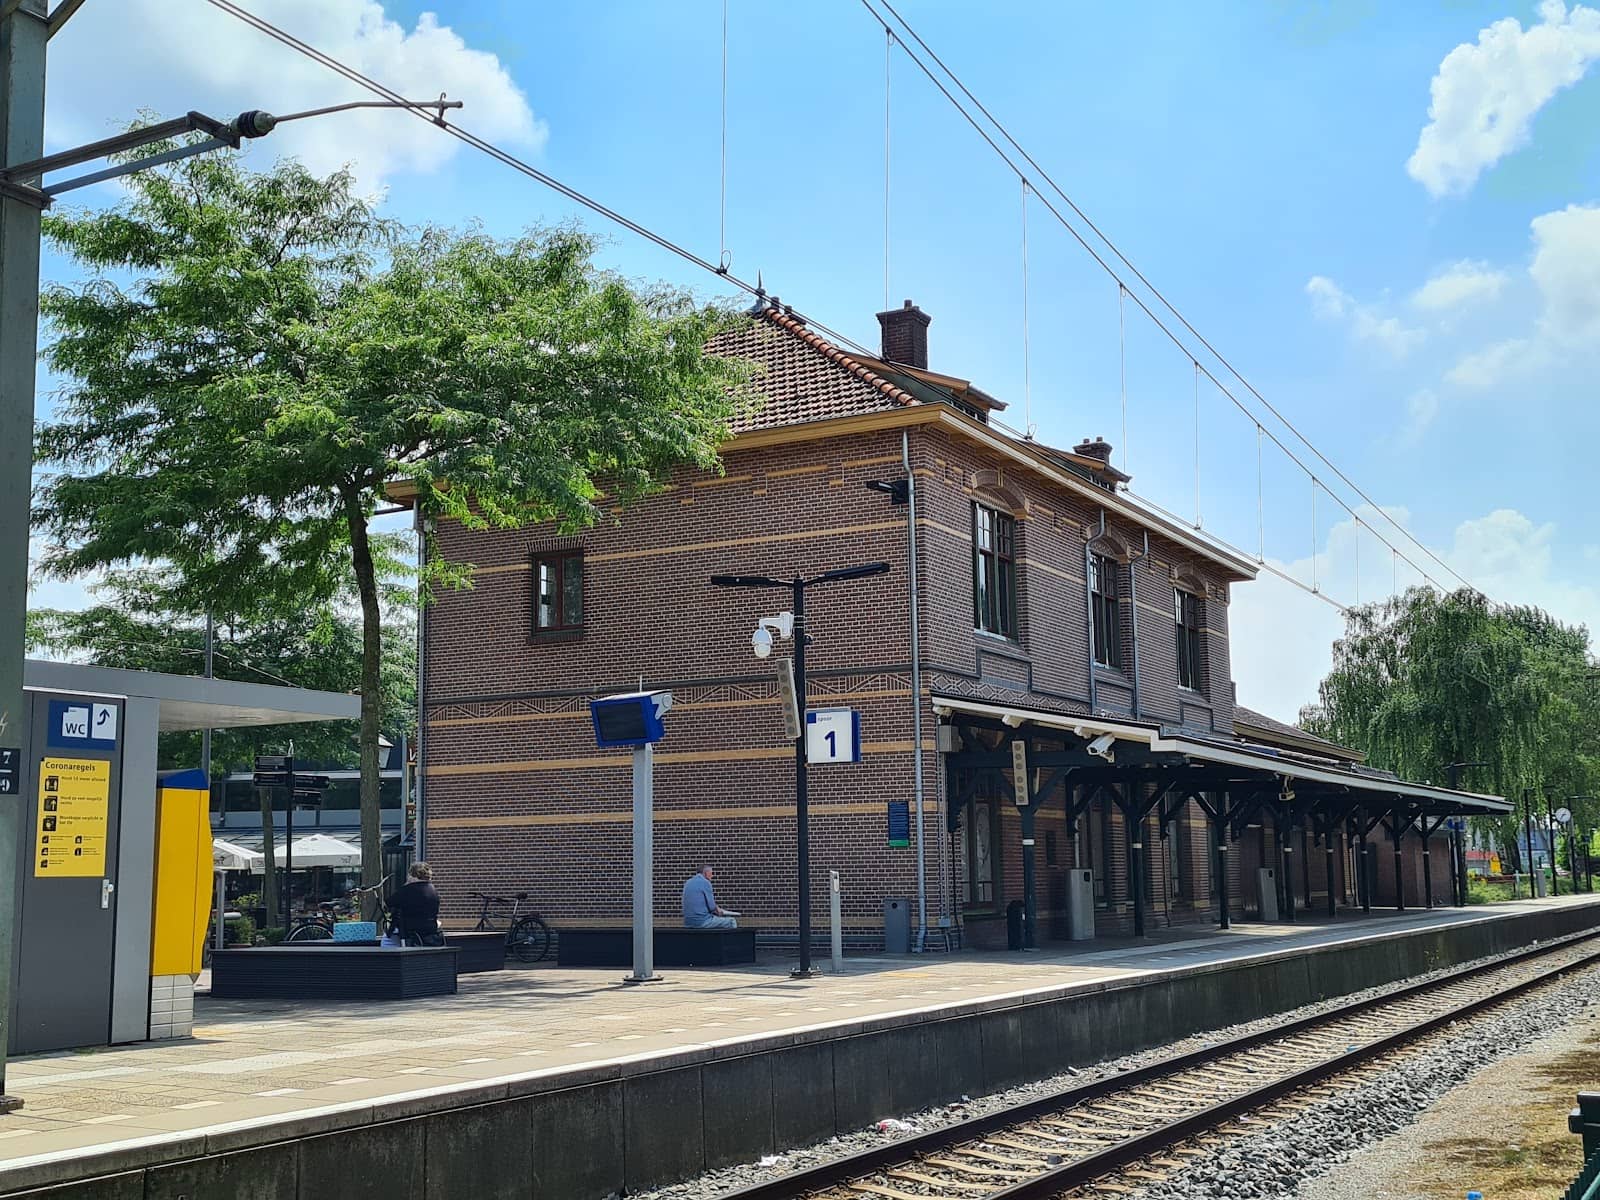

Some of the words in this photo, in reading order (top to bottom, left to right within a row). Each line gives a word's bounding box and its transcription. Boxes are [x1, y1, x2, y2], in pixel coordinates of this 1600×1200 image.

[65, 723, 86, 735] WC
[824, 730, 836, 758] 1
[45, 762, 95, 772] Coronaregels
